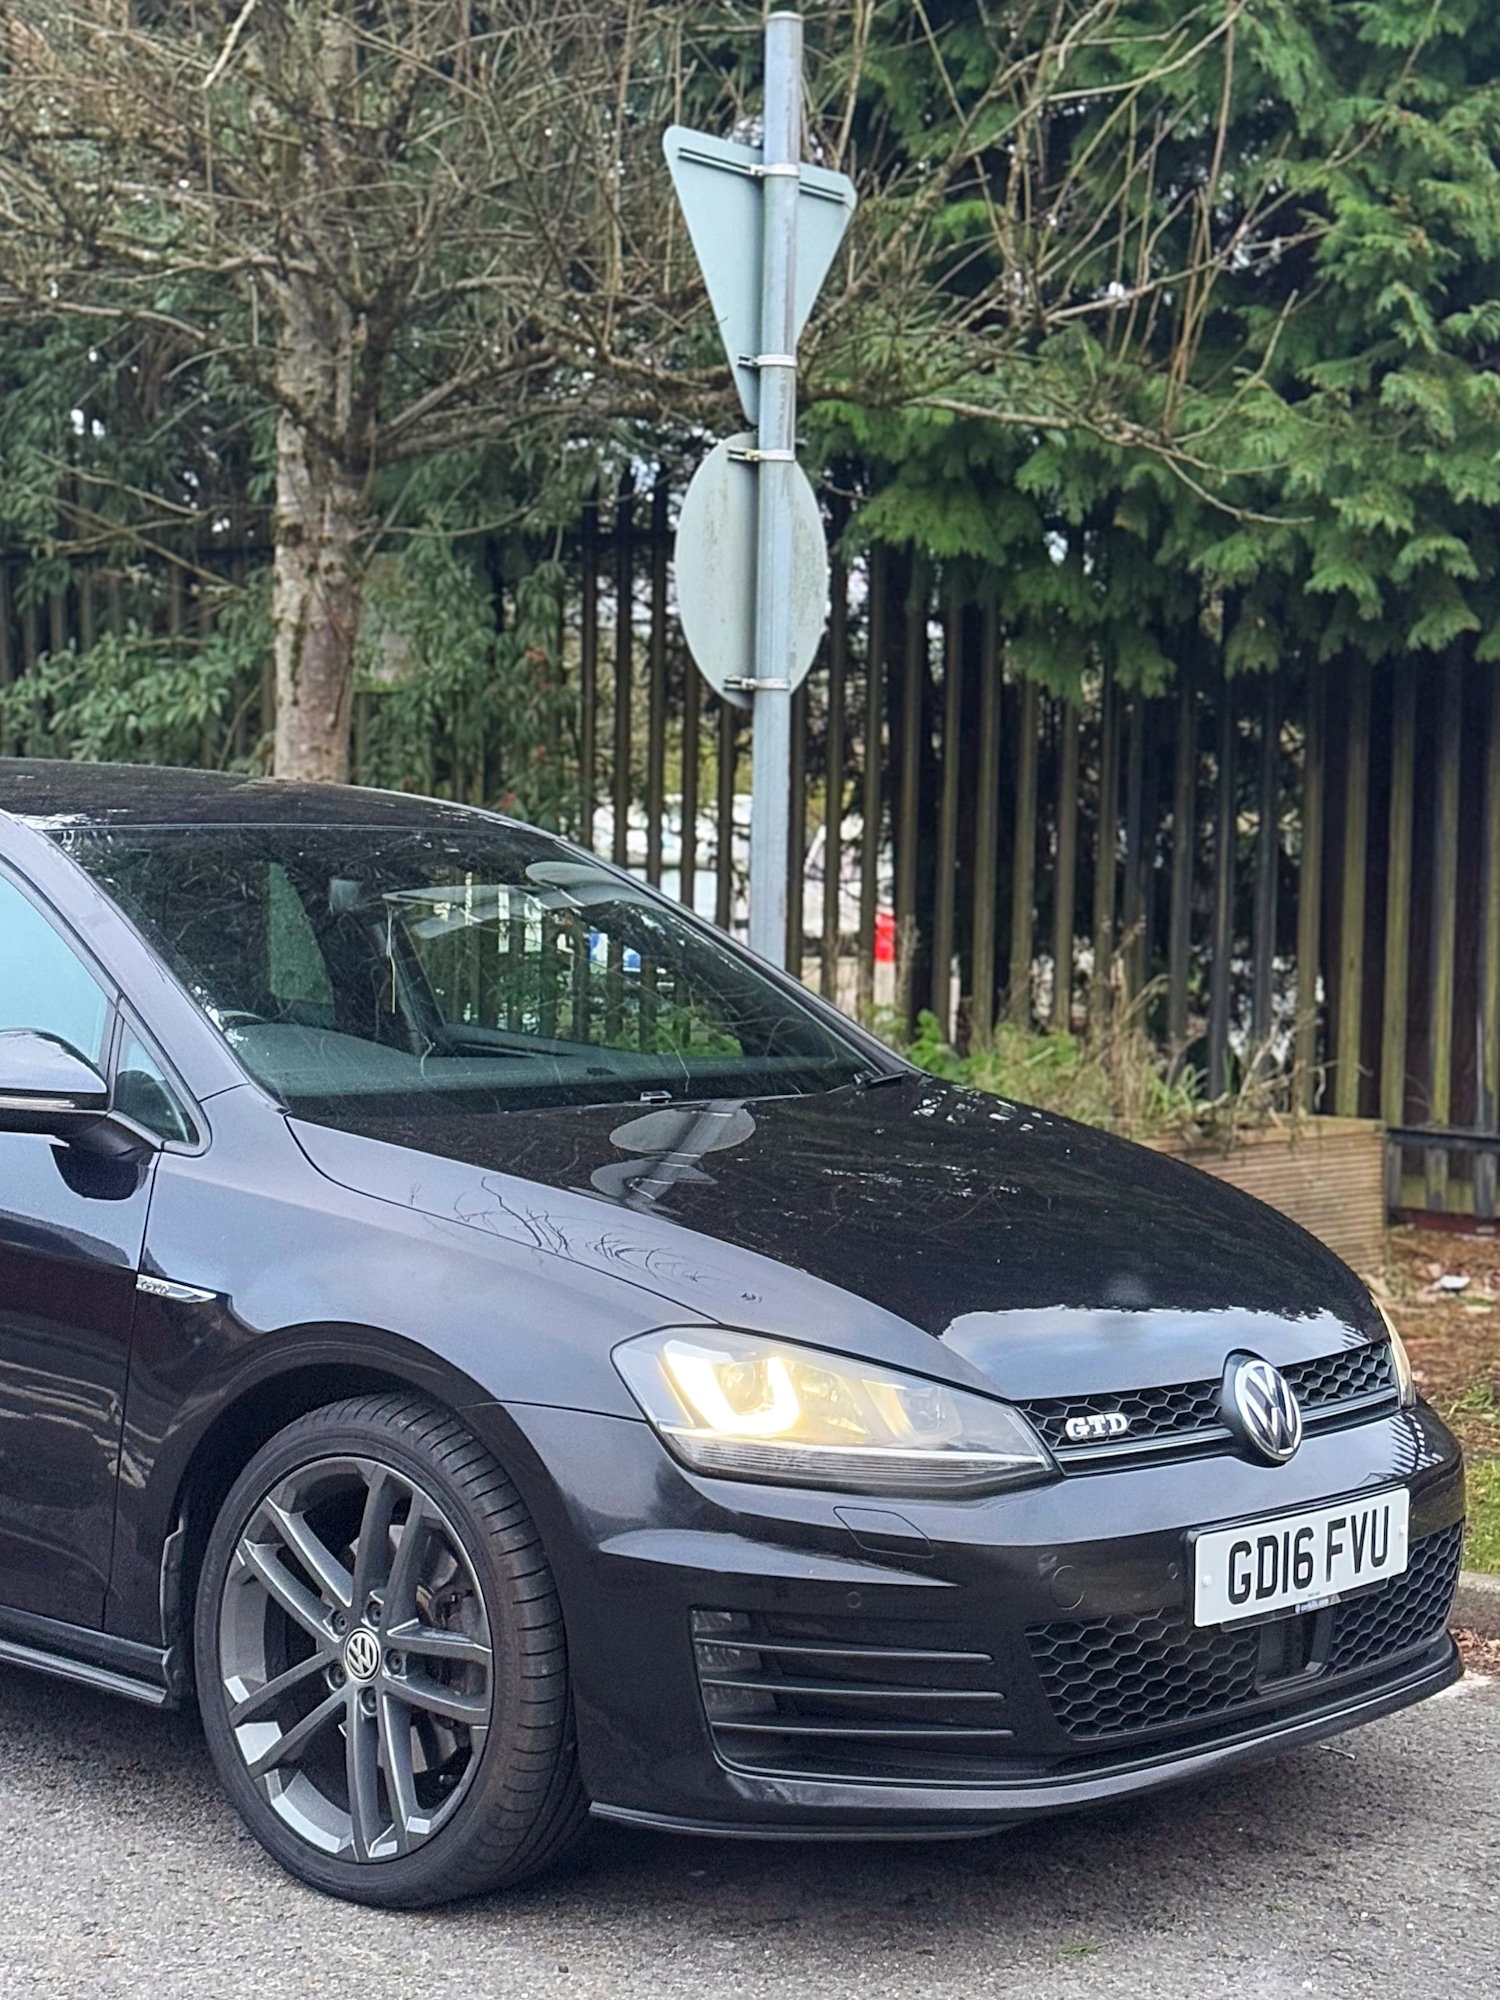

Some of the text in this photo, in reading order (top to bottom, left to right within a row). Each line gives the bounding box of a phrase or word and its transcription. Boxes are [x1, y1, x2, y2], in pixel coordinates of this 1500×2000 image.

[1065, 1413, 1128, 1441] GTD
[1228, 1505, 1390, 1605] GD16 FVU
